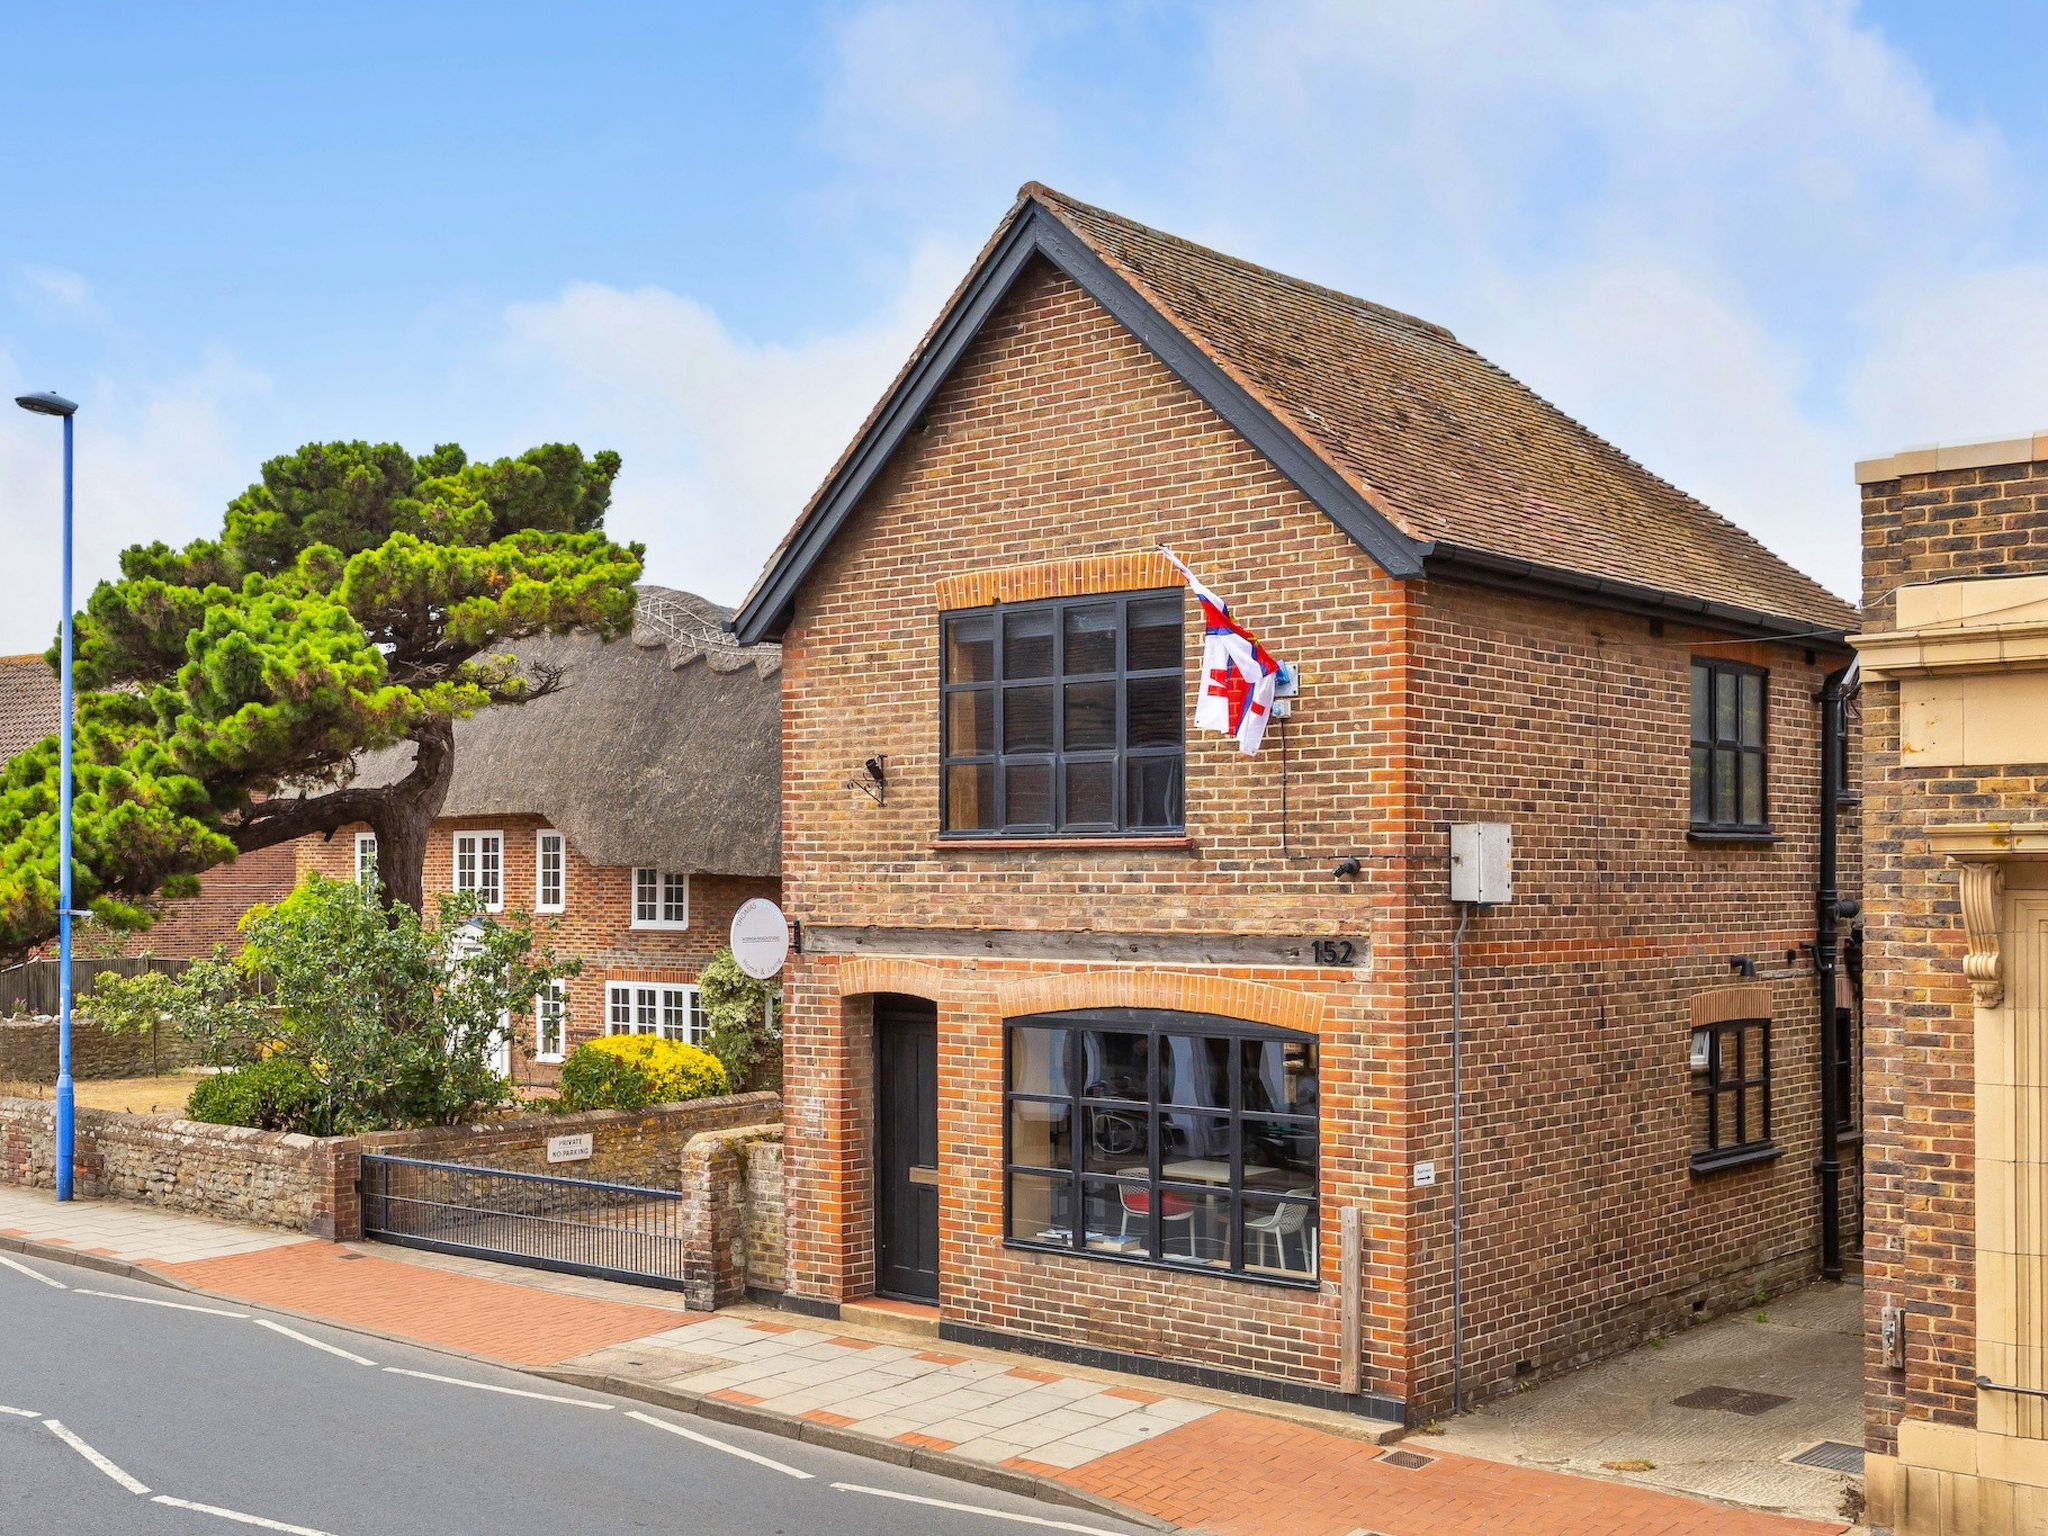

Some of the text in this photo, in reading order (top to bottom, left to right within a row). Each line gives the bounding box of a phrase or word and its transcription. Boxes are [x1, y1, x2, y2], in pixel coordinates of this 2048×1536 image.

[1311, 940, 1353, 964] 152
[558, 1138, 582, 1146] PRIVATE
[562, 1148, 589, 1157] PARKING
